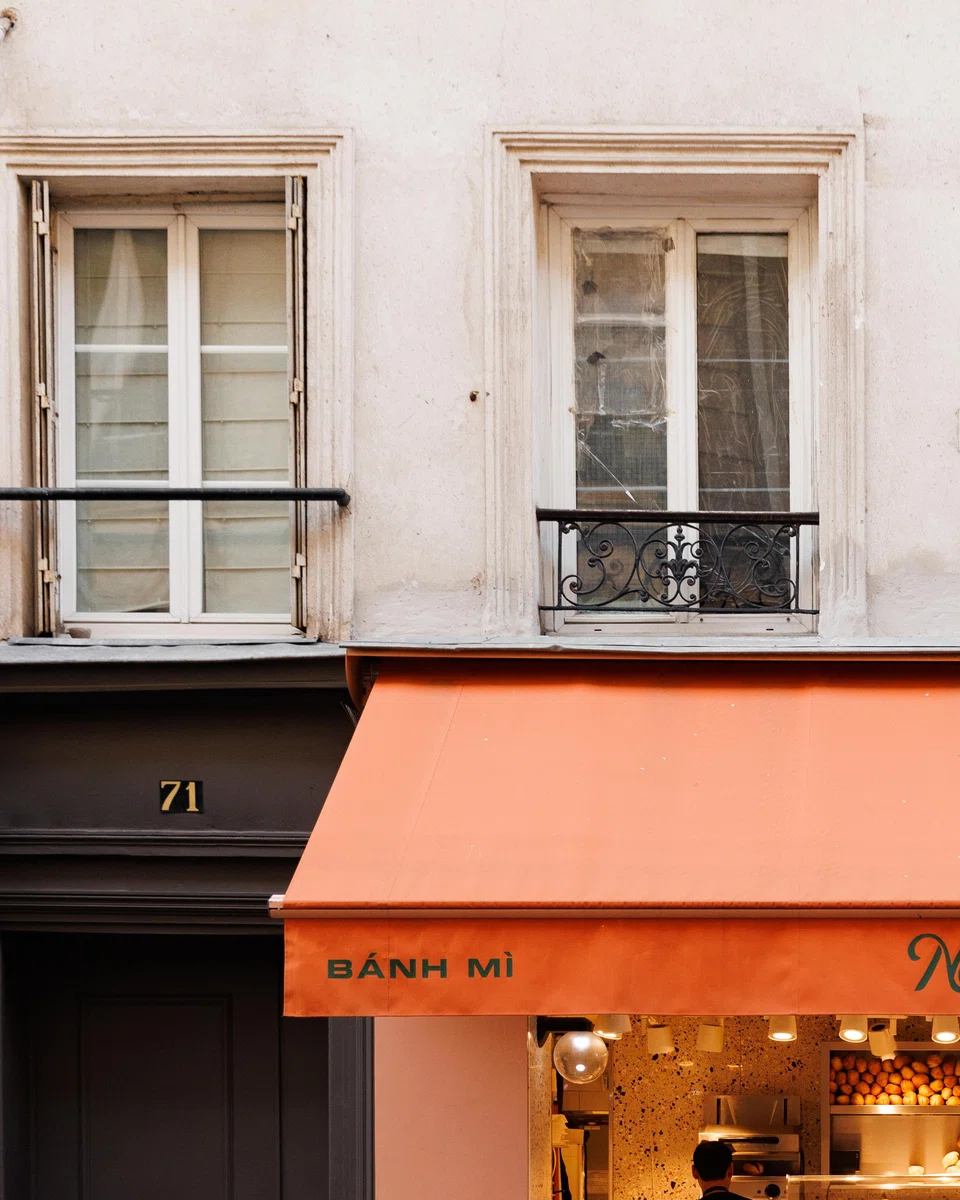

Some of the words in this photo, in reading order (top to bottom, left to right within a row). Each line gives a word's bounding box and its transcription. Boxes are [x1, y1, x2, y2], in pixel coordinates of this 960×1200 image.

[160, 780, 200, 812] 71
[327, 952, 448, 979] BÁNH
[468, 951, 513, 978] MÌ
